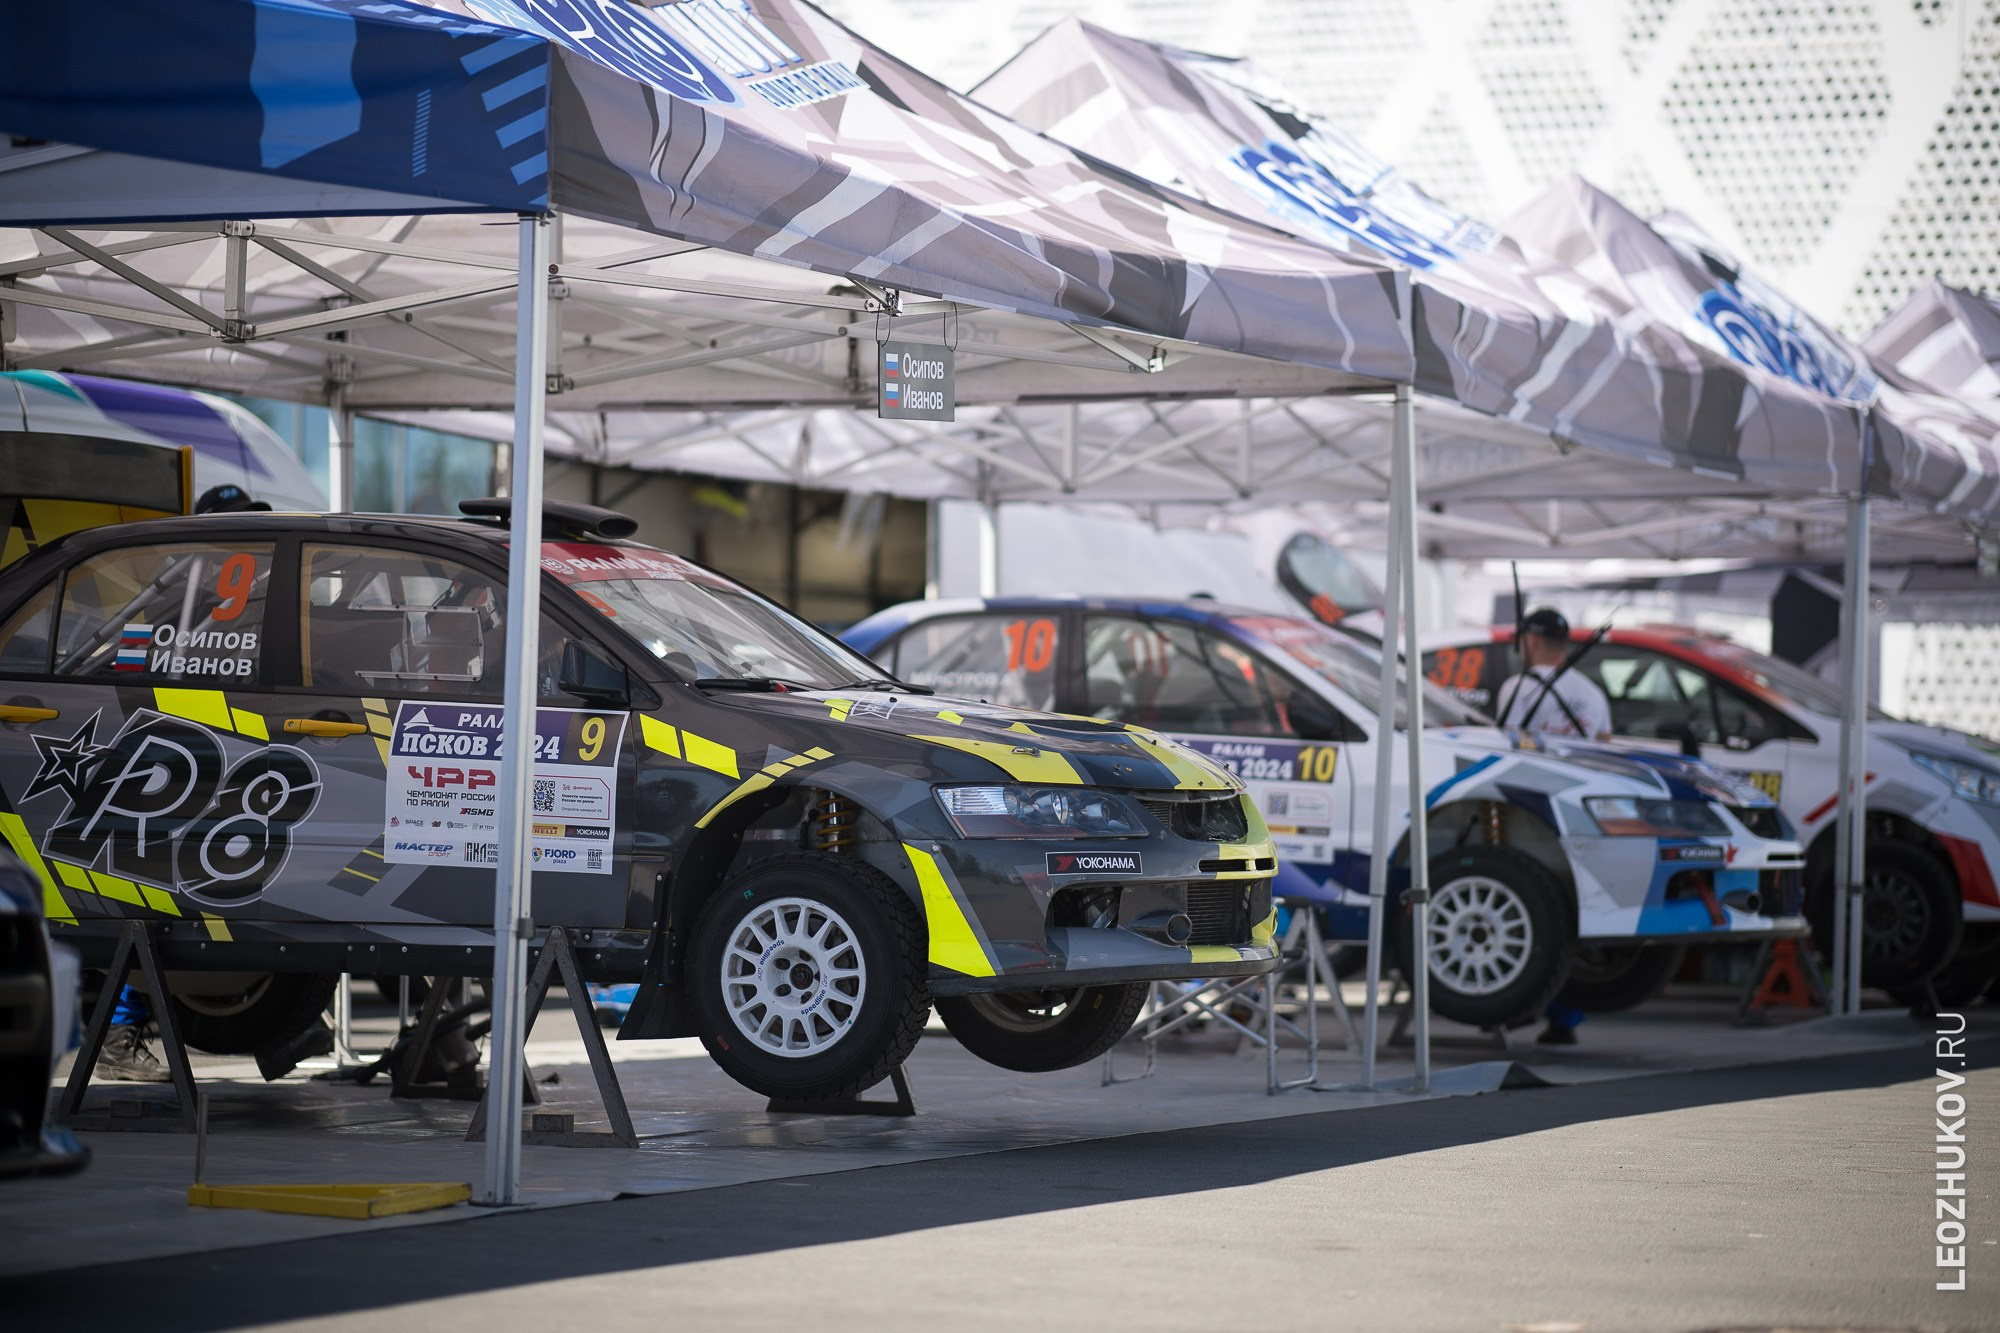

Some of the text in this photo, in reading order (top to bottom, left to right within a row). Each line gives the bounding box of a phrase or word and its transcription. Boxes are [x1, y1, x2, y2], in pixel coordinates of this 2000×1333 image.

[793, 70, 832, 97] DE
[902, 352, 944, 380] Осипов
[902, 383, 944, 410] Иванов
[566, 557, 648, 571] РАЛЛИ
[211, 553, 256, 621] 9
[154, 624, 257, 650] Осипов
[1005, 619, 1057, 673] 10
[150, 649, 252, 676] Иванов
[1428, 647, 1485, 690] 38
[457, 713, 504, 729] РАЛ
[400, 733, 560, 760] ПСКОВ 224
[579, 717, 606, 762] 9
[1211, 744, 1265, 758] РАЛЛИ
[1240, 759, 1294, 779] 2024
[1298, 746, 1336, 782] 10
[42, 708, 323, 907] R8
[406, 790, 496, 802] ЧЕМПИОНАТ РОССИИ
[420, 800, 450, 808] РАЛЛИ
[462, 807, 494, 817] ASMG
[533, 825, 557, 835] RELLI
[576, 828, 608, 837] YOKOHAMA
[394, 842, 453, 852] МАСТЕР
[544, 848, 577, 859] FJORD
[1076, 857, 1136, 869] YOKOHAMA
[759, 939, 785, 966] speedline
[801, 989, 826, 1015] speedline
